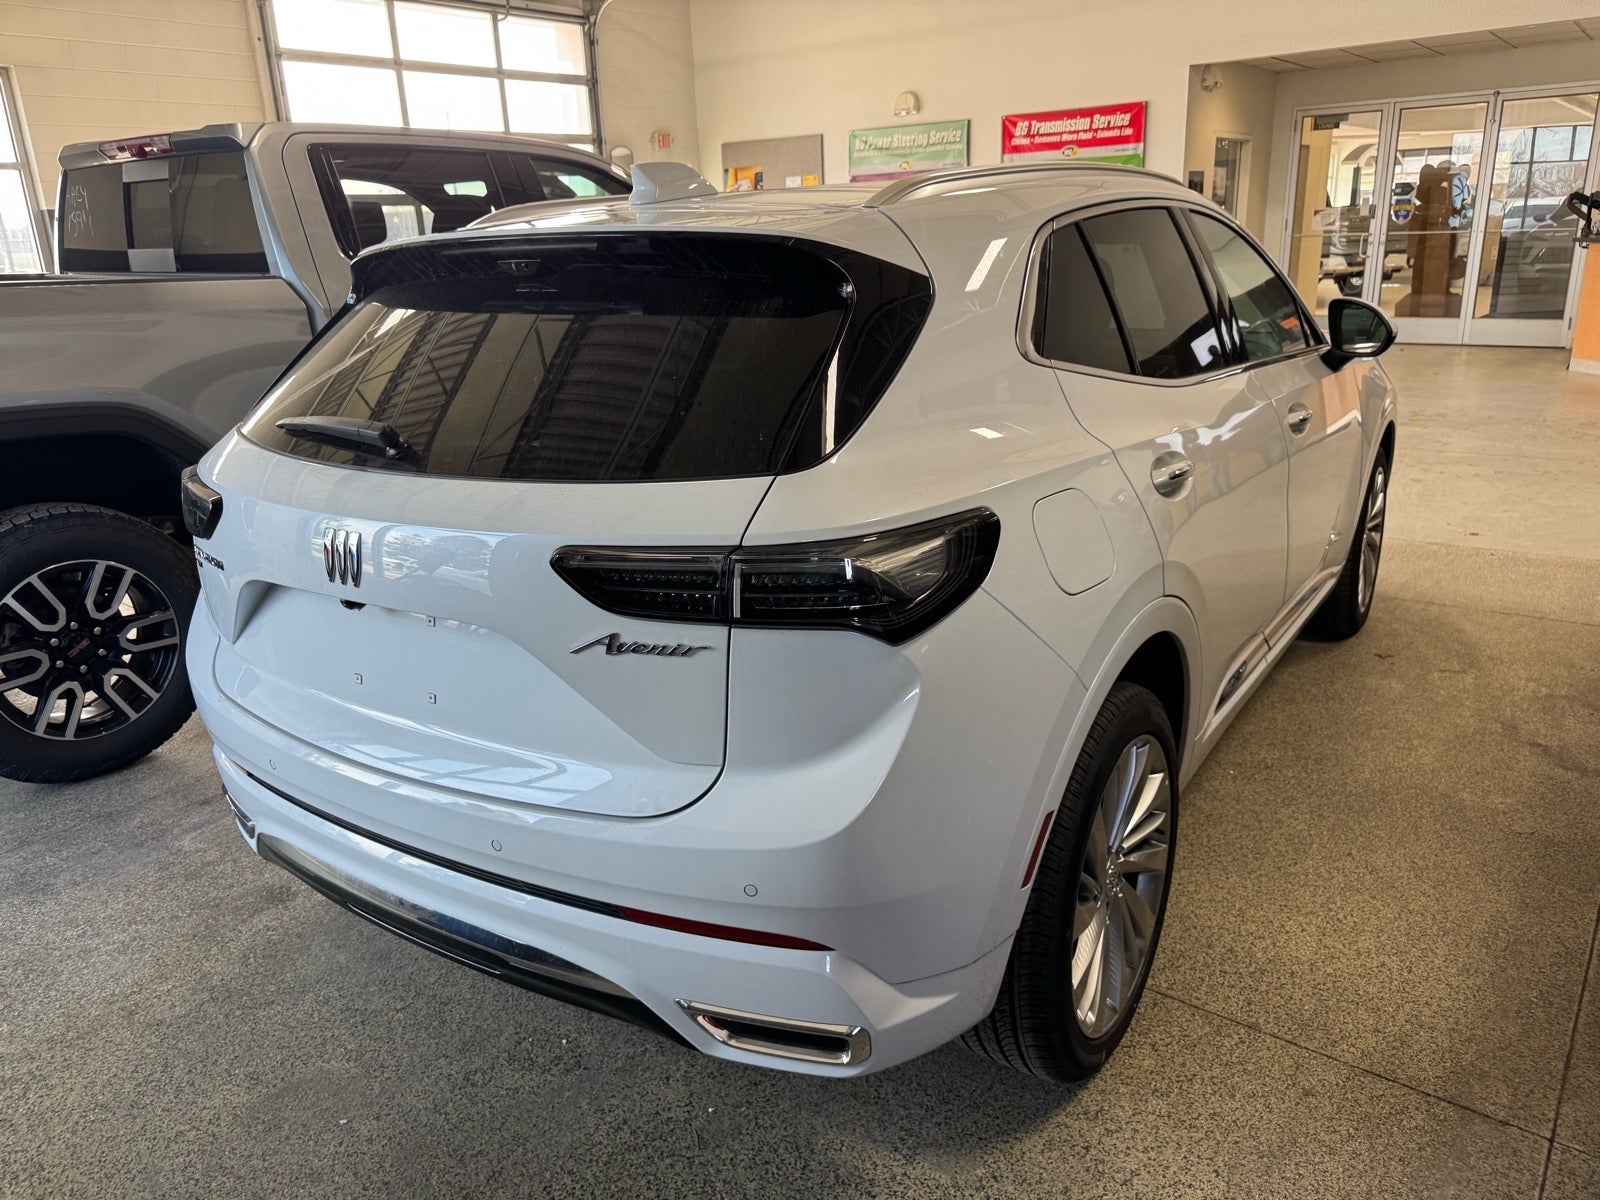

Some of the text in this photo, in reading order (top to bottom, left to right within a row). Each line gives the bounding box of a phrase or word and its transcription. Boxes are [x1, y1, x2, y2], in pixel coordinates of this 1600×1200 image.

[1029, 115, 1091, 136] Transmission
[1091, 111, 1132, 130] Service
[865, 136, 891, 150] Power
[891, 131, 929, 148] Steering
[928, 127, 962, 144] Service
[569, 632, 715, 657] Avenir
